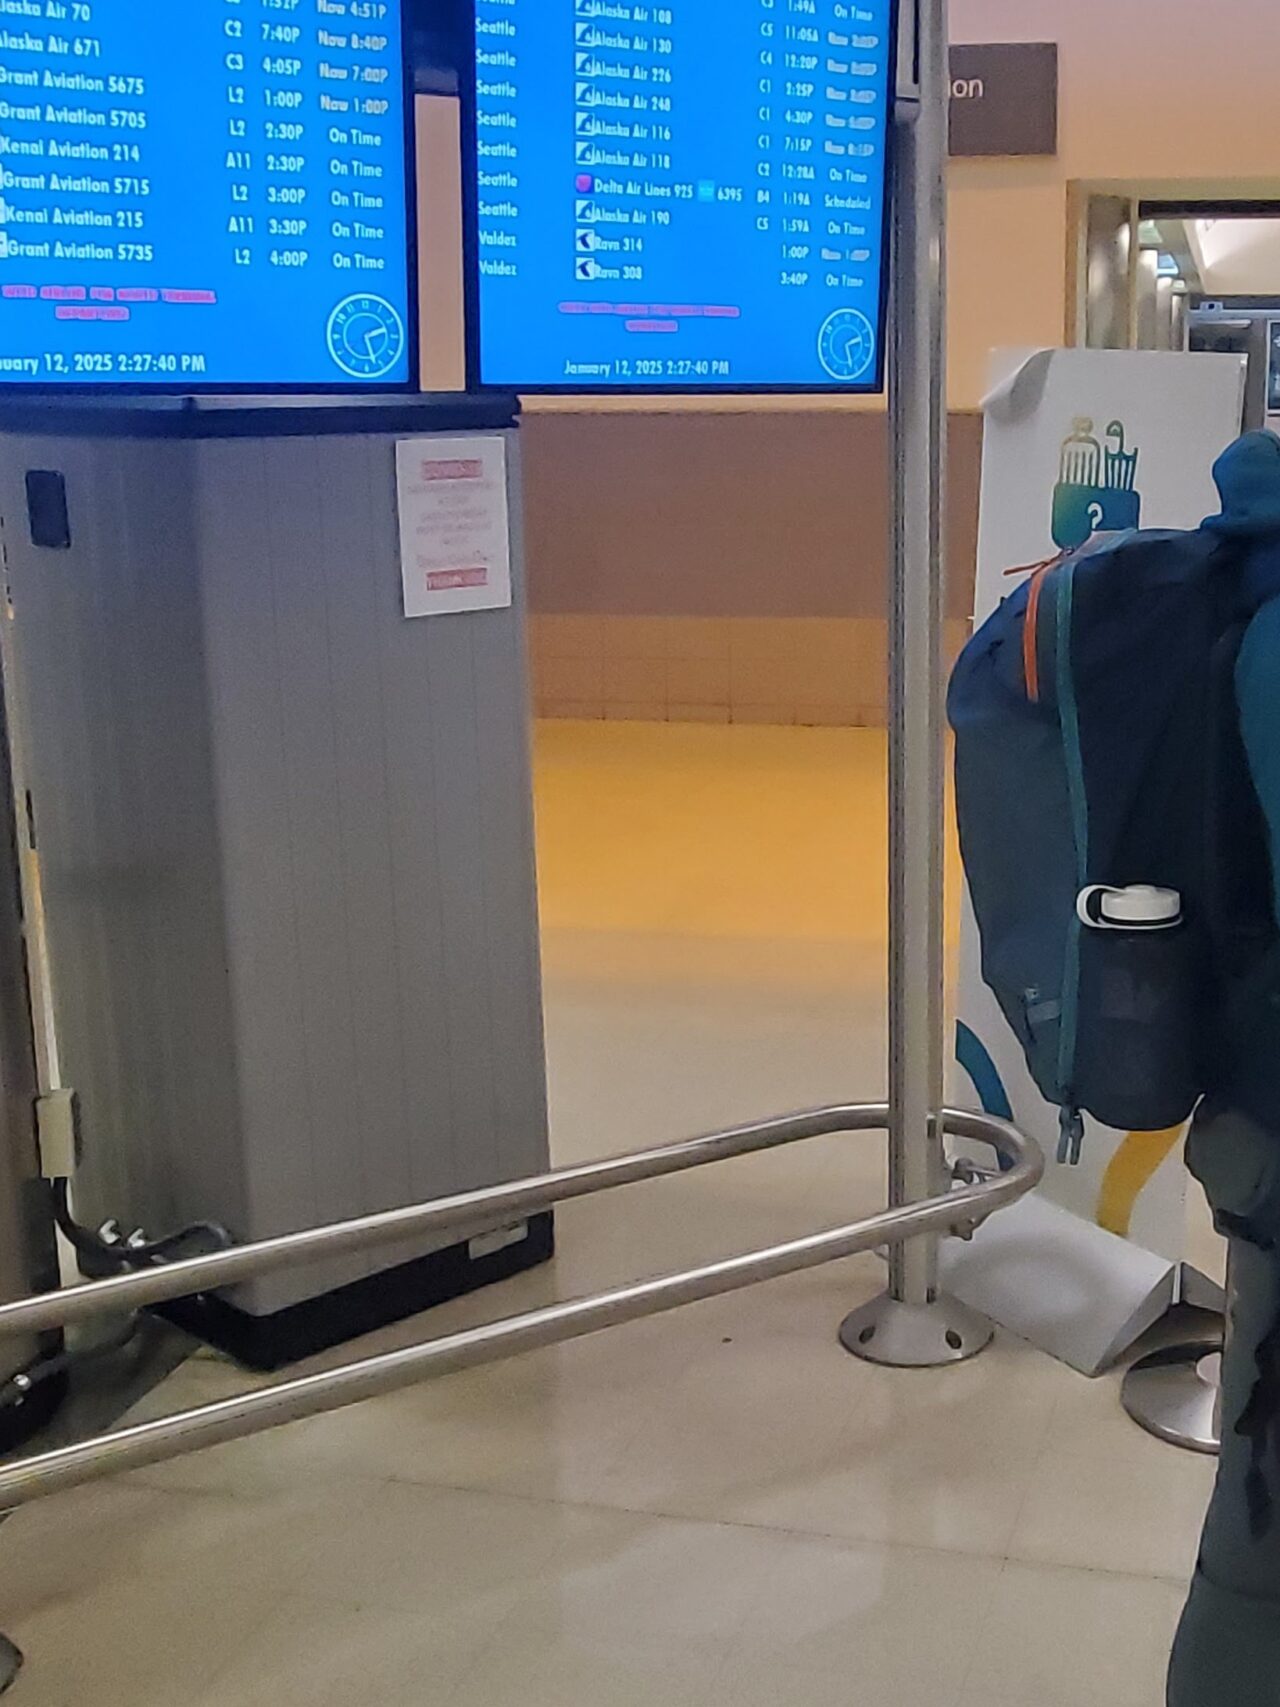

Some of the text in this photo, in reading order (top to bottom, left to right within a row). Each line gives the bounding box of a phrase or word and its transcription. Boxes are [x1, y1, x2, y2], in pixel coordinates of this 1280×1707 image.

[0, 0, 90, 21] laska Air 70
[317, 0, 386, 18] Now 4:51P
[596, 2, 630, 19] Alaska
[634, 7, 648, 20] Air
[835, 4, 847, 17] On
[225, 20, 241, 37] C2
[262, 24, 300, 42] 7:40P
[475, 17, 515, 36] Seattle
[0, 31, 99, 56] laska Air 671
[318, 30, 387, 50] Now 8:40P
[596, 32, 671, 53] Alaska Air 130
[226, 53, 243, 70] C3
[476, 48, 516, 66] Seattle
[263, 57, 301, 75] 4:05P
[319, 63, 388, 82] Now 7:00P
[596, 62, 671, 82] Alaska Air 226
[43, 70, 103, 91] Aviation
[108, 76, 143, 94] 5675
[476, 79, 516, 97] Seattle
[229, 87, 243, 103] L2
[265, 90, 302, 107] 1:00P
[596, 92, 629, 107] Alaska
[633, 95, 647, 108] Air
[320, 95, 388, 114] Now 1:00P
[0, 102, 146, 128] Grant Aviation 5705
[476, 110, 516, 127] Seattle
[230, 120, 245, 136] L2
[266, 123, 303, 139] 2:30P
[329, 128, 381, 145] On Time
[596, 121, 670, 140] Alaska Air 116
[1, 136, 139, 161] Kenai Aviation 214
[477, 140, 516, 157] Seattle
[226, 152, 250, 168] A11
[267, 155, 304, 171] 2:30P
[596, 150, 629, 165] Alaska
[633, 153, 647, 166] Air
[331, 159, 382, 177] On Time
[830, 168, 842, 180] On
[3, 171, 149, 195] Grant Aviation 5715
[478, 171, 517, 186] Seattle
[233, 185, 247, 200] L2
[268, 187, 305, 203] 3:00P
[594, 179, 623, 193] Delta
[627, 181, 641, 194] Air
[645, 183, 671, 196] Lines
[674, 185, 692, 198] 925
[332, 191, 382, 207] On Time
[825, 194, 870, 209] Scheduled
[6, 206, 143, 227] Kenai Aviation 215
[478, 201, 517, 216] Seattle
[596, 208, 669, 224] Alaska Air 190
[229, 216, 252, 232] A11
[269, 219, 307, 235] 3:30P
[332, 222, 383, 238] On Time
[828, 222, 840, 233] On
[479, 230, 516, 246] Valdez
[623, 238, 642, 251] 314
[8, 240, 152, 260] Grant Aviation 5735
[235, 249, 249, 264] L2
[270, 251, 308, 266] 4:00P
[333, 253, 384, 269] On Time
[479, 260, 516, 275] Valdez
[781, 272, 808, 285] 3:40P
[826, 274, 838, 286] On
[45, 354, 68, 373] 12,
[74, 354, 112, 371] 2025
[118, 354, 176, 371] 2:27:40
[181, 355, 205, 371] PM
[565, 360, 728, 377] January 12, 2025 2:27:40 PM
